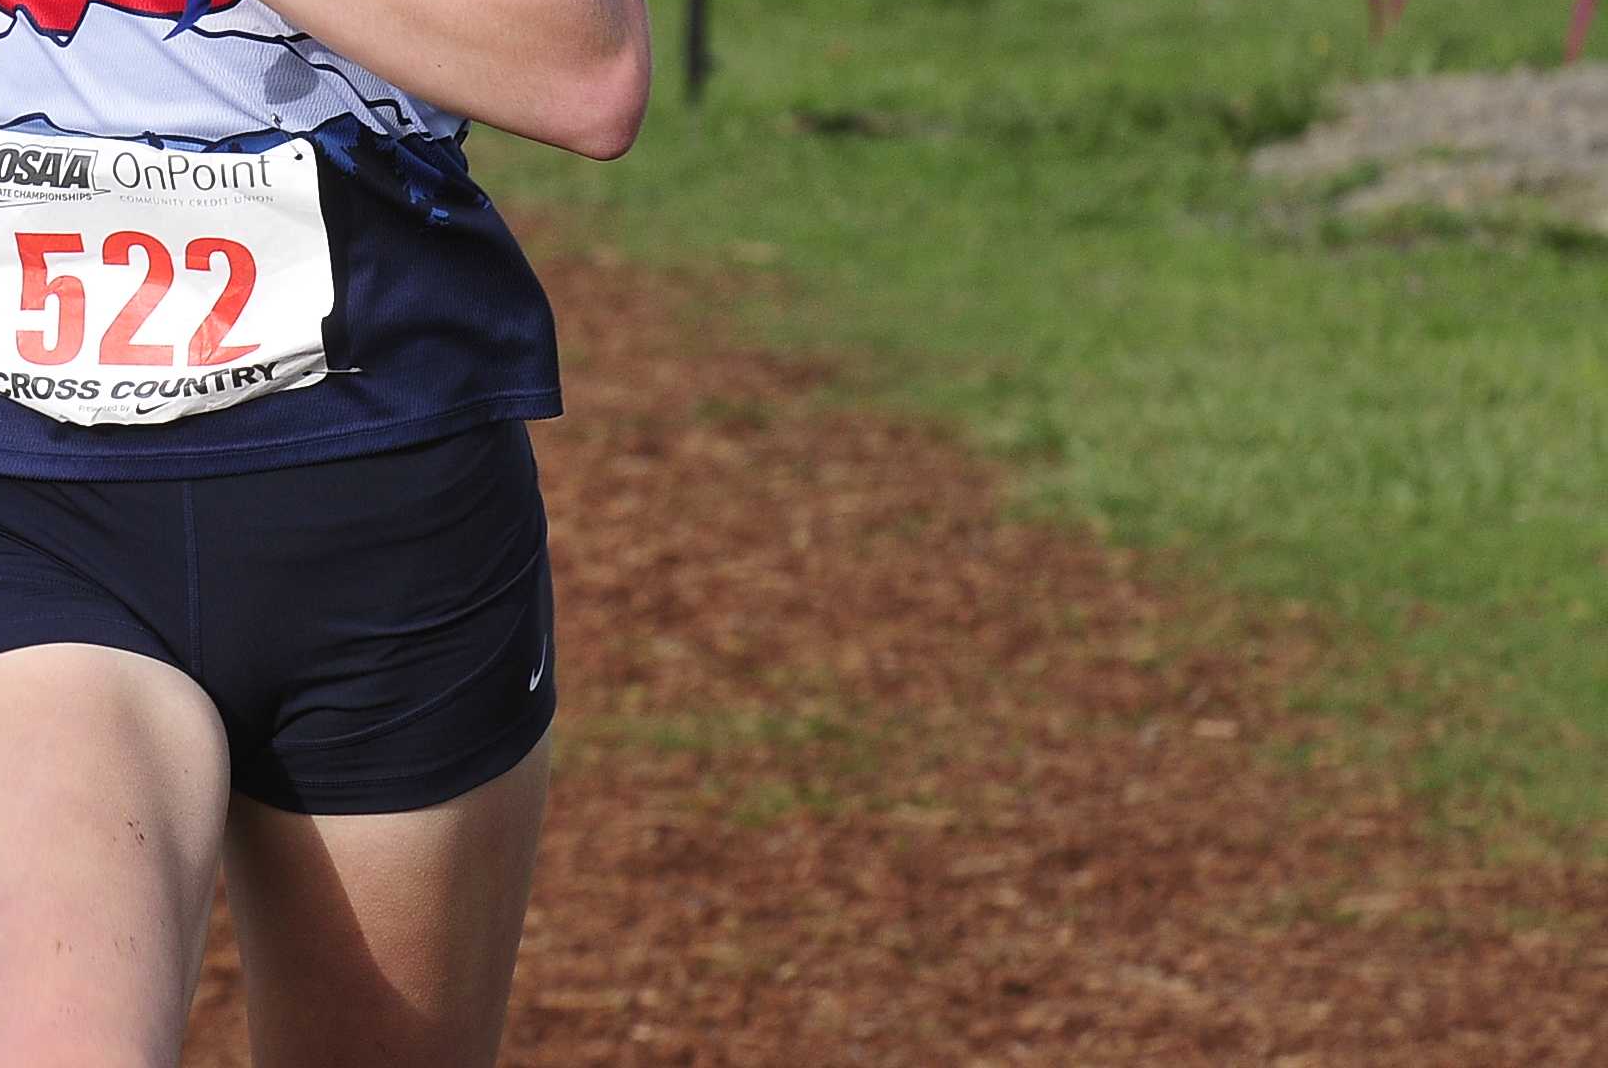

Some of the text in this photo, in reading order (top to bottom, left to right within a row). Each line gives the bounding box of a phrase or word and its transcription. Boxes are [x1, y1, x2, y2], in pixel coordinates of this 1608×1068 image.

[112, 151, 272, 191] OnPoint
[13, 189, 93, 202] CHAMPIONSHIPS
[119, 194, 275, 207] COMMUNITY CREDIT UNION
[14, 230, 261, 367] 522
[110, 360, 281, 400] COUNTRY
